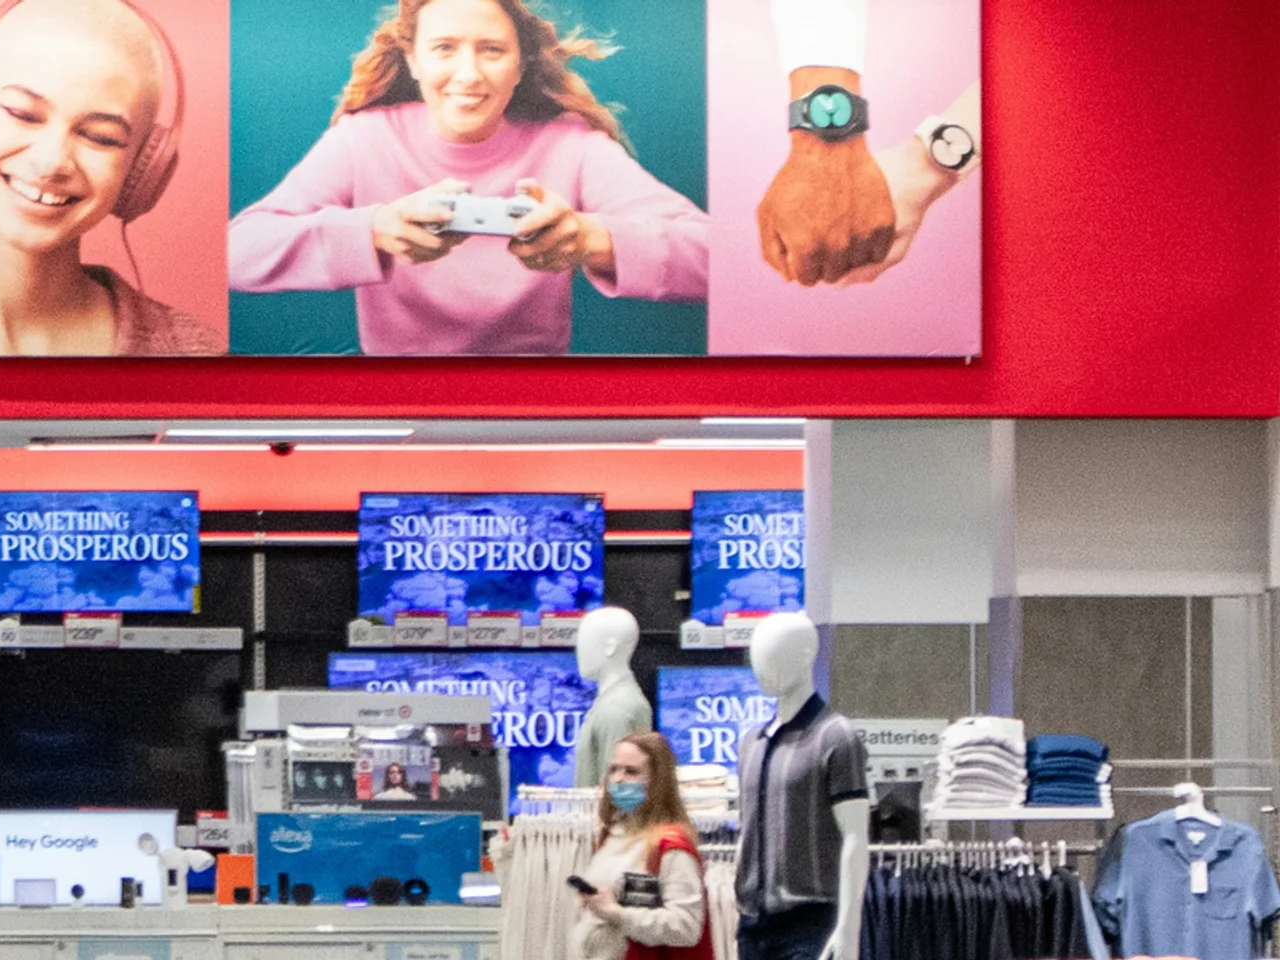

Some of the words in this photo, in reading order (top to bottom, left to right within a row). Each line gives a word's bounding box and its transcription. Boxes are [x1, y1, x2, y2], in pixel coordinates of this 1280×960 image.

[6, 511, 130, 532] SOMETHING
[390, 514, 528, 538] SOMETHING
[724, 513, 804, 536] SOMET
[0, 533, 189, 562] PROSPEROUS
[383, 540, 592, 571] PROSPEROUS
[717, 539, 807, 570] PROS
[695, 696, 778, 724] SOME
[6, 835, 36, 850] Hey
[40, 834, 99, 851] Google
